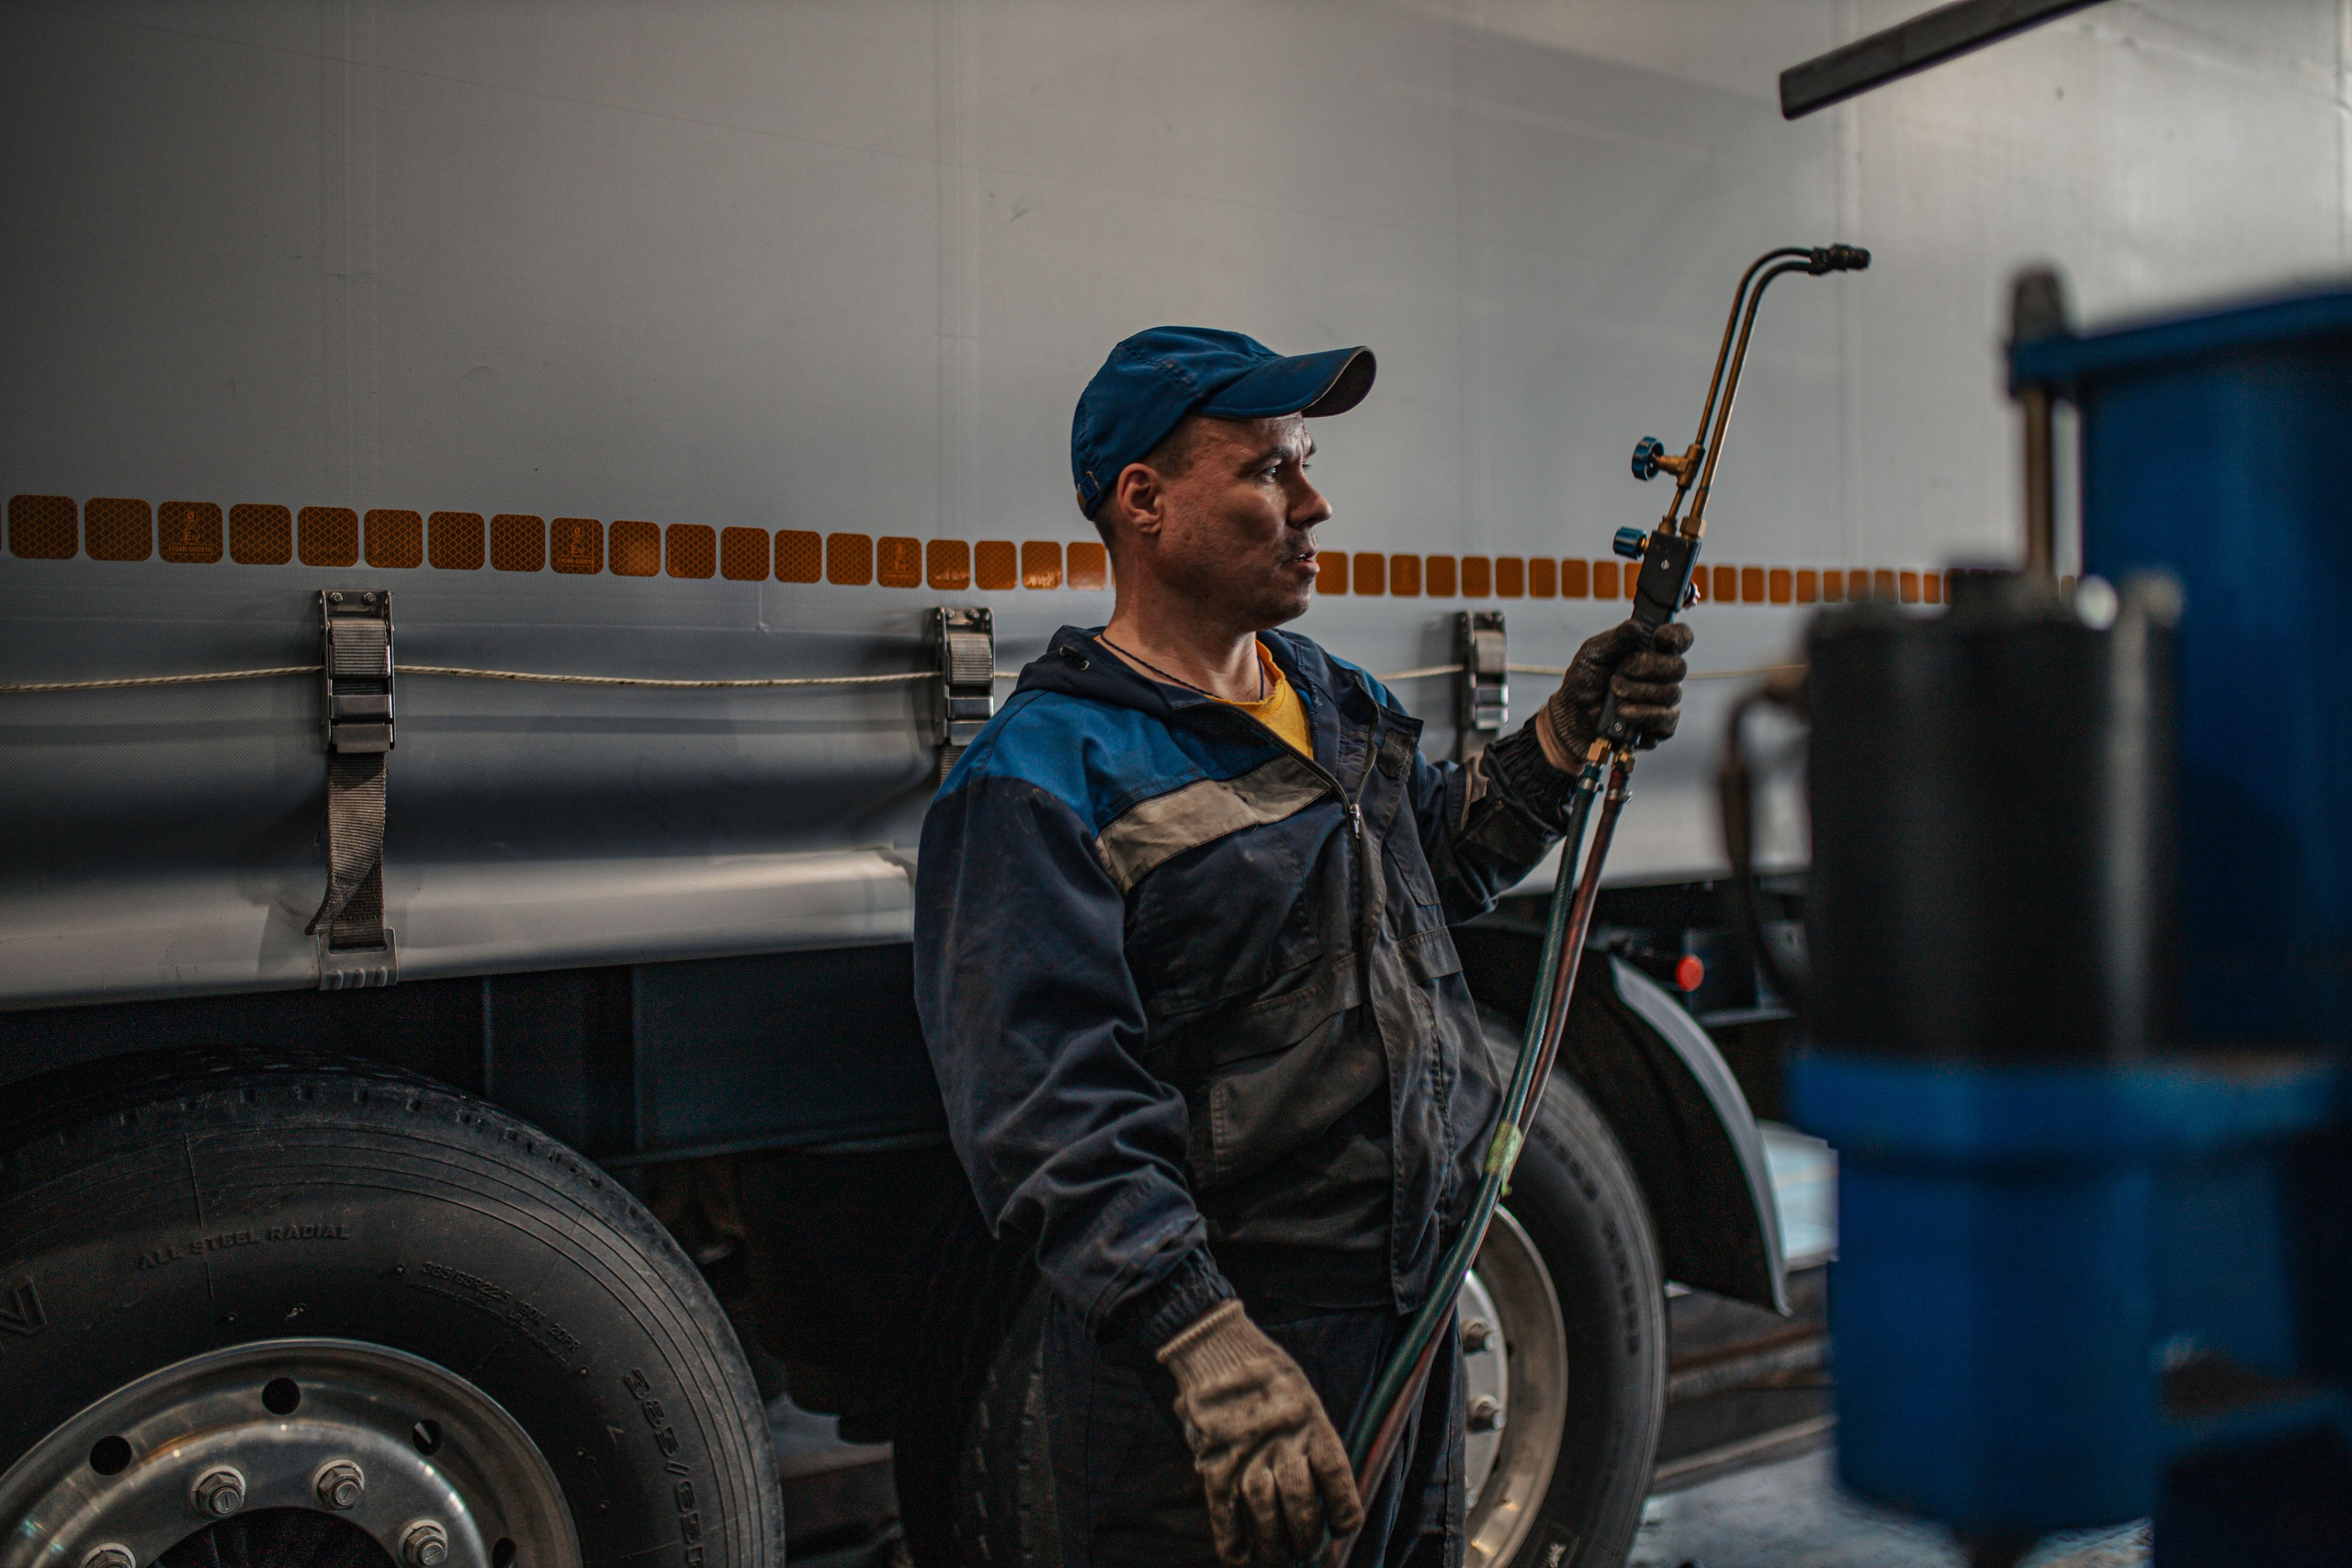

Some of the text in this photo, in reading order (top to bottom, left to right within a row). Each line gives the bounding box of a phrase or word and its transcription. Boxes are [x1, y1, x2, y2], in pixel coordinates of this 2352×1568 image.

[138, 1224, 350, 1269] ALL STEEL RADIAL
[421, 1260, 514, 1303] 385/65R22.5
[548, 1323, 581, 1351] 20PR
